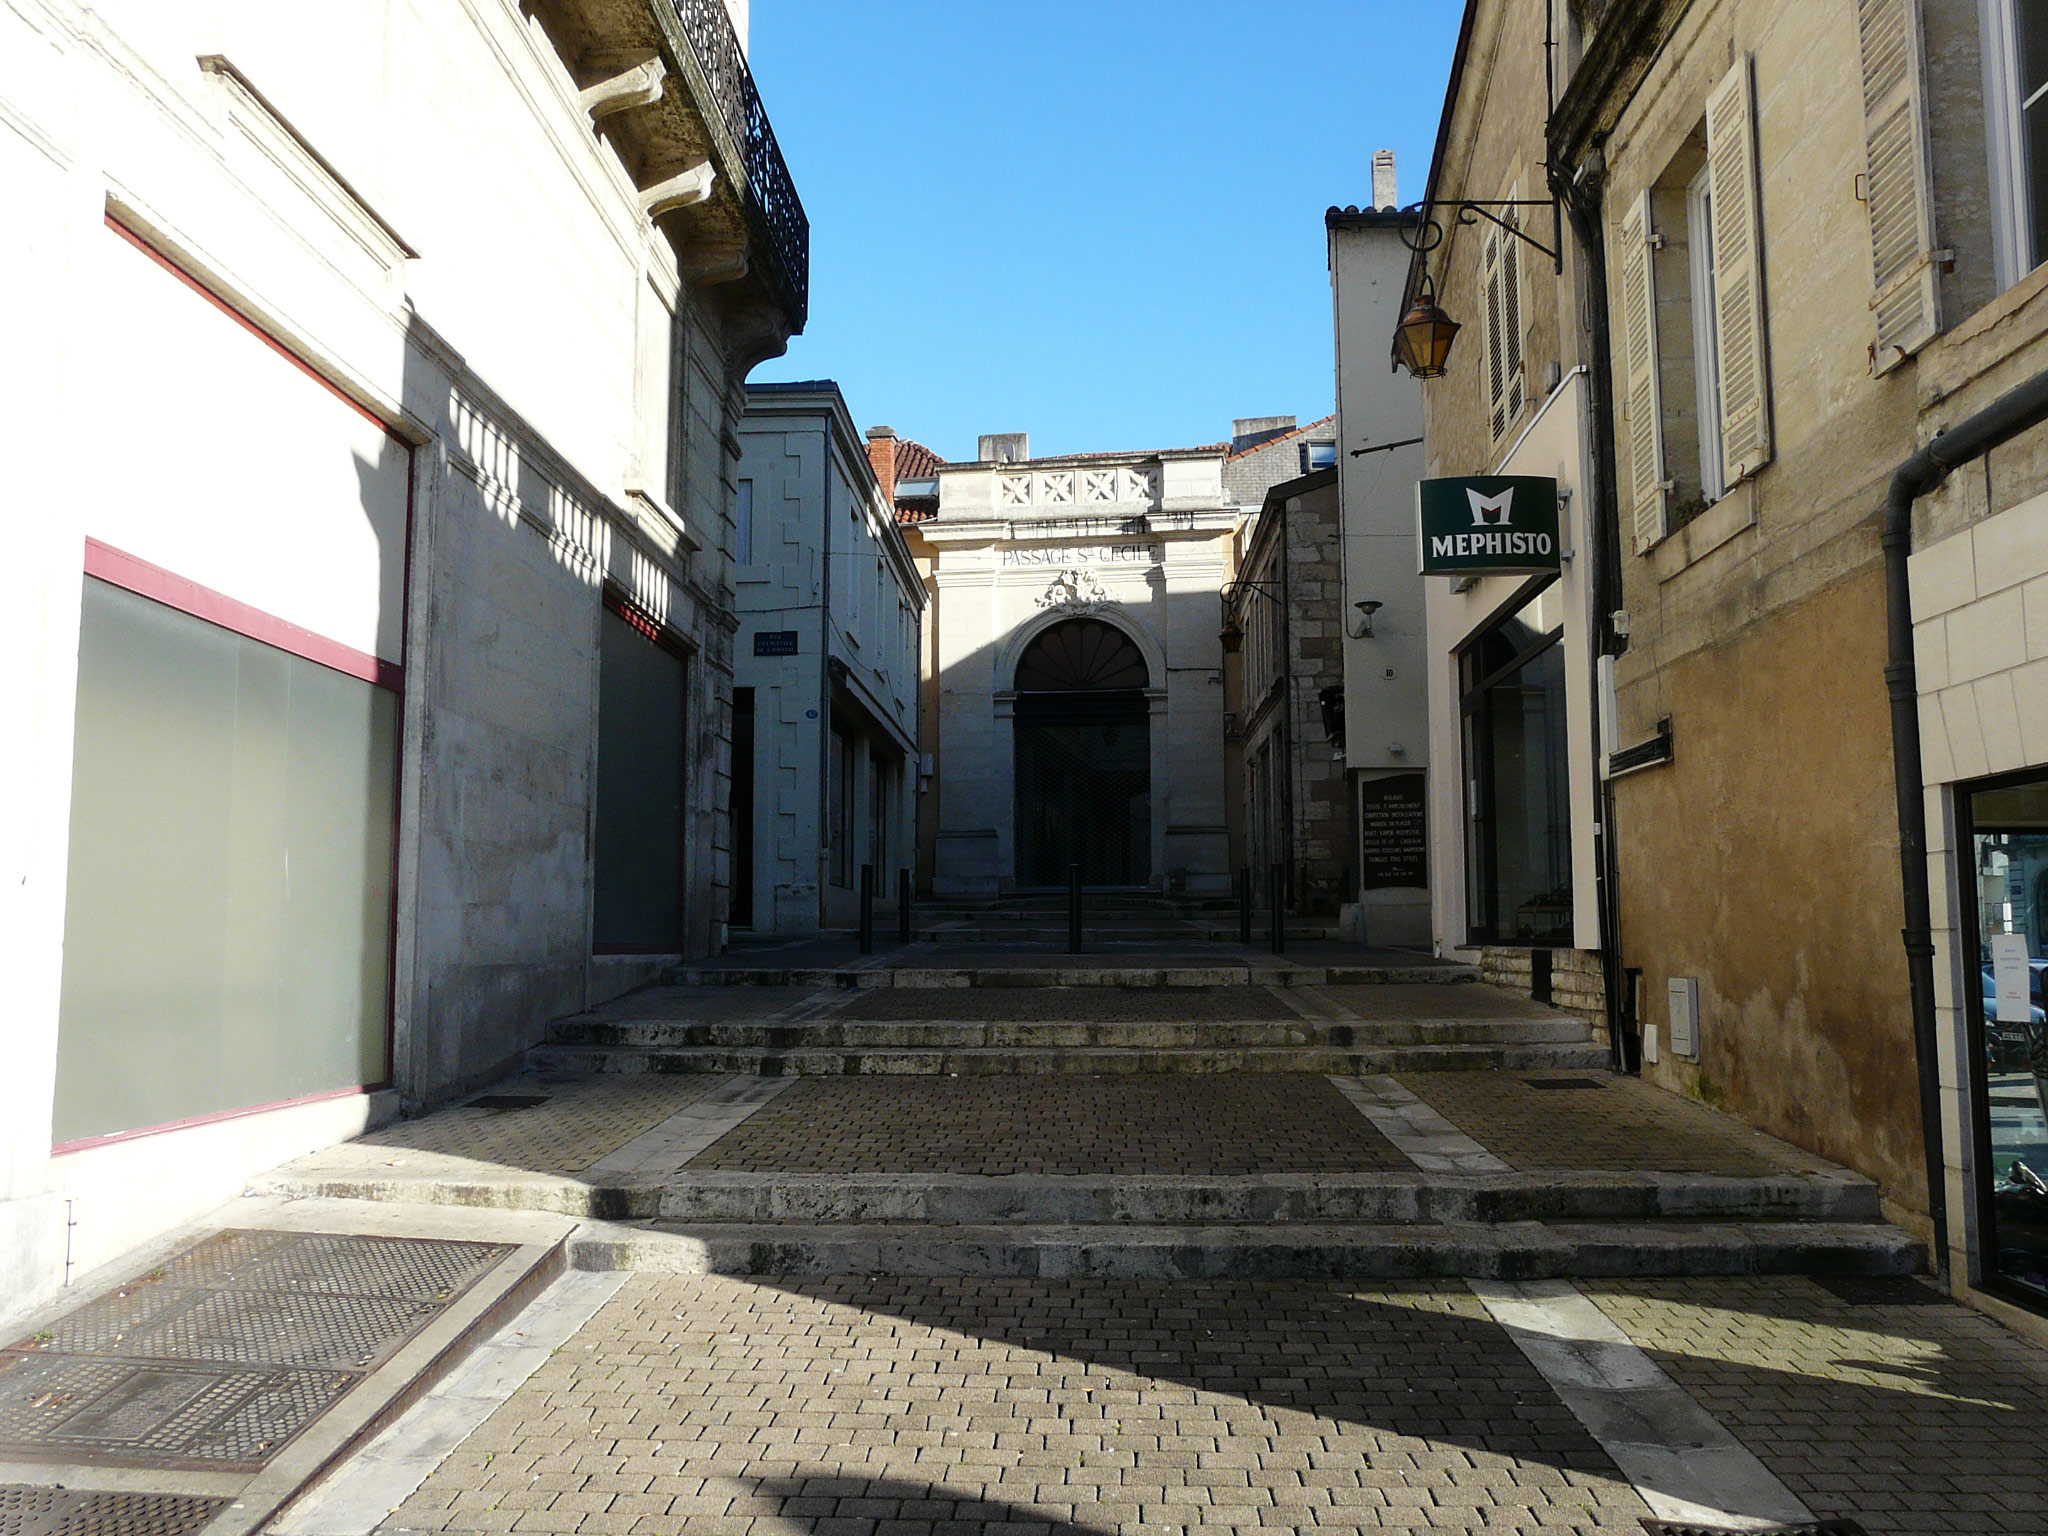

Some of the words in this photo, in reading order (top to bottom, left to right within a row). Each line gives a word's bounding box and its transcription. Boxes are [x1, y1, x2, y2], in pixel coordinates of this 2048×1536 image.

[1430, 532, 1552, 558] MEPHISTO
[1003, 549, 1072, 566] PASSAGE
[1386, 668, 1394, 677] 10
